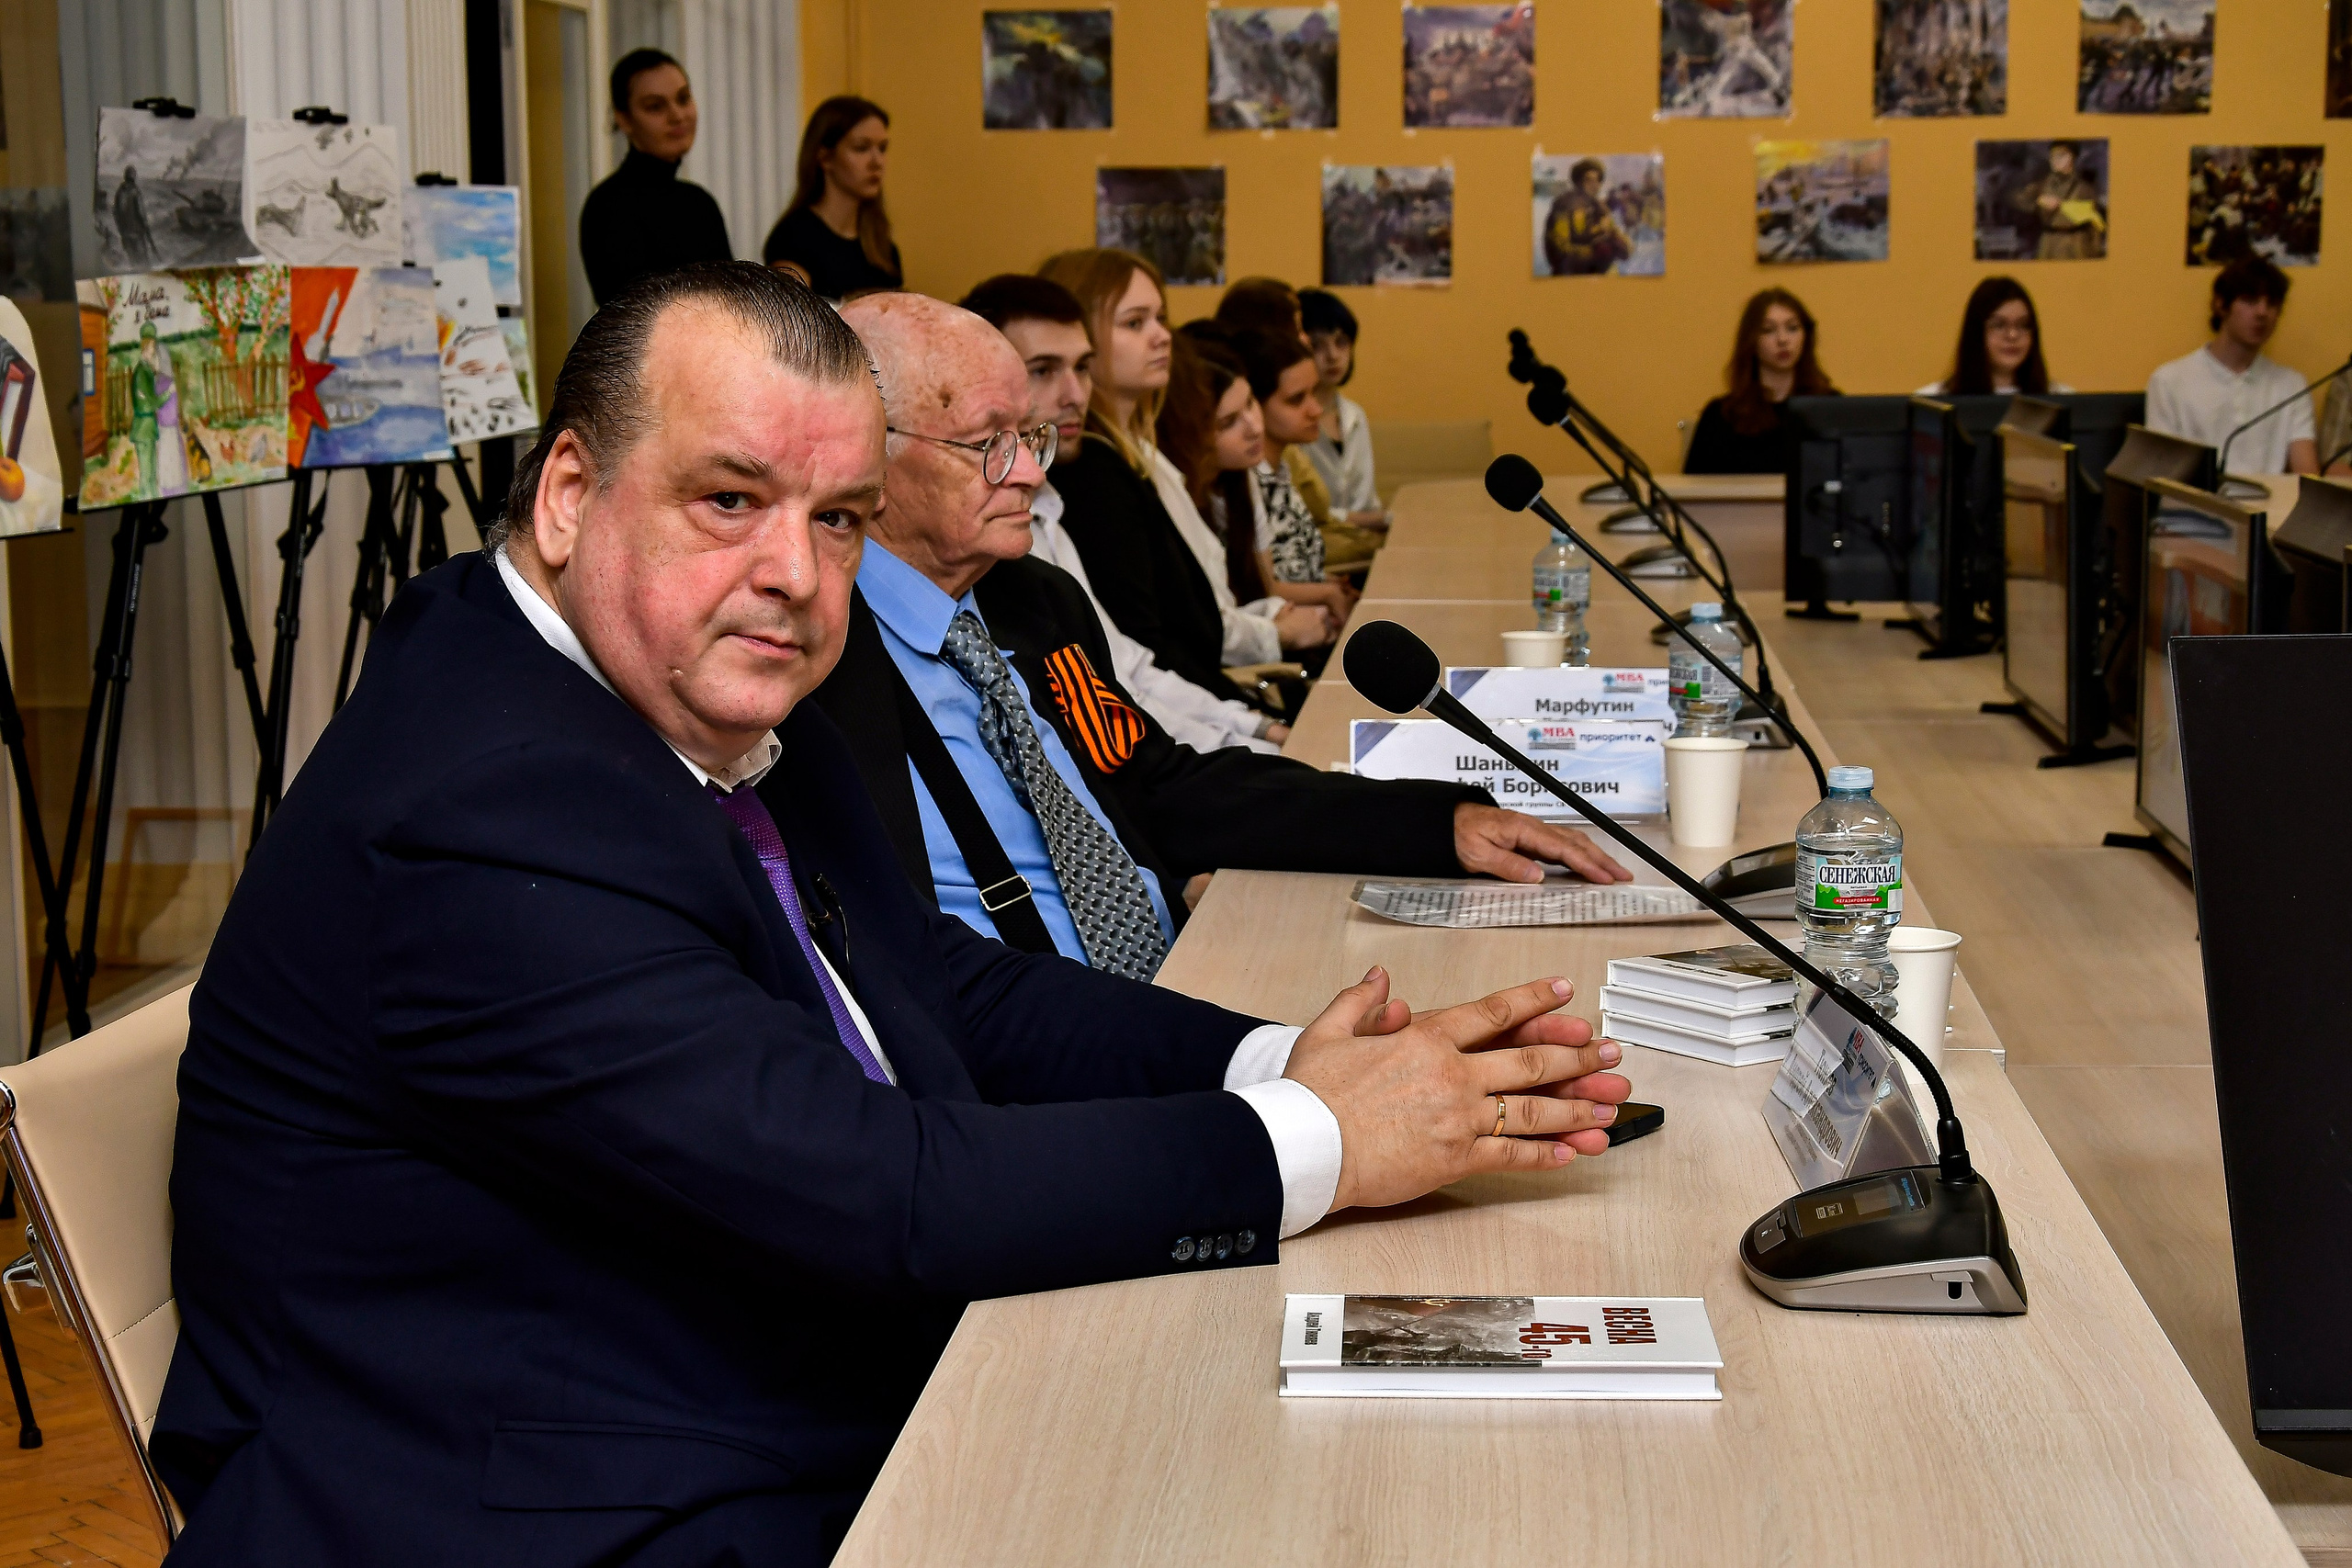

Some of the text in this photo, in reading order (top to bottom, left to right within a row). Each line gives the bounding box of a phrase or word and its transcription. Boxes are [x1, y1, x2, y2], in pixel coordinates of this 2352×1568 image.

[1536, 698, 1634, 715] Марфутин
[1544, 727, 1575, 737] МВА
[1580, 734, 1641, 742] приоритет
[1456, 755, 1559, 771] Шаньин
[1503, 777, 1620, 796] Борович
[1819, 865, 1895, 884] СЕНЕЖСКАЯ
[1602, 1307, 1657, 1345] ВЕСНА
